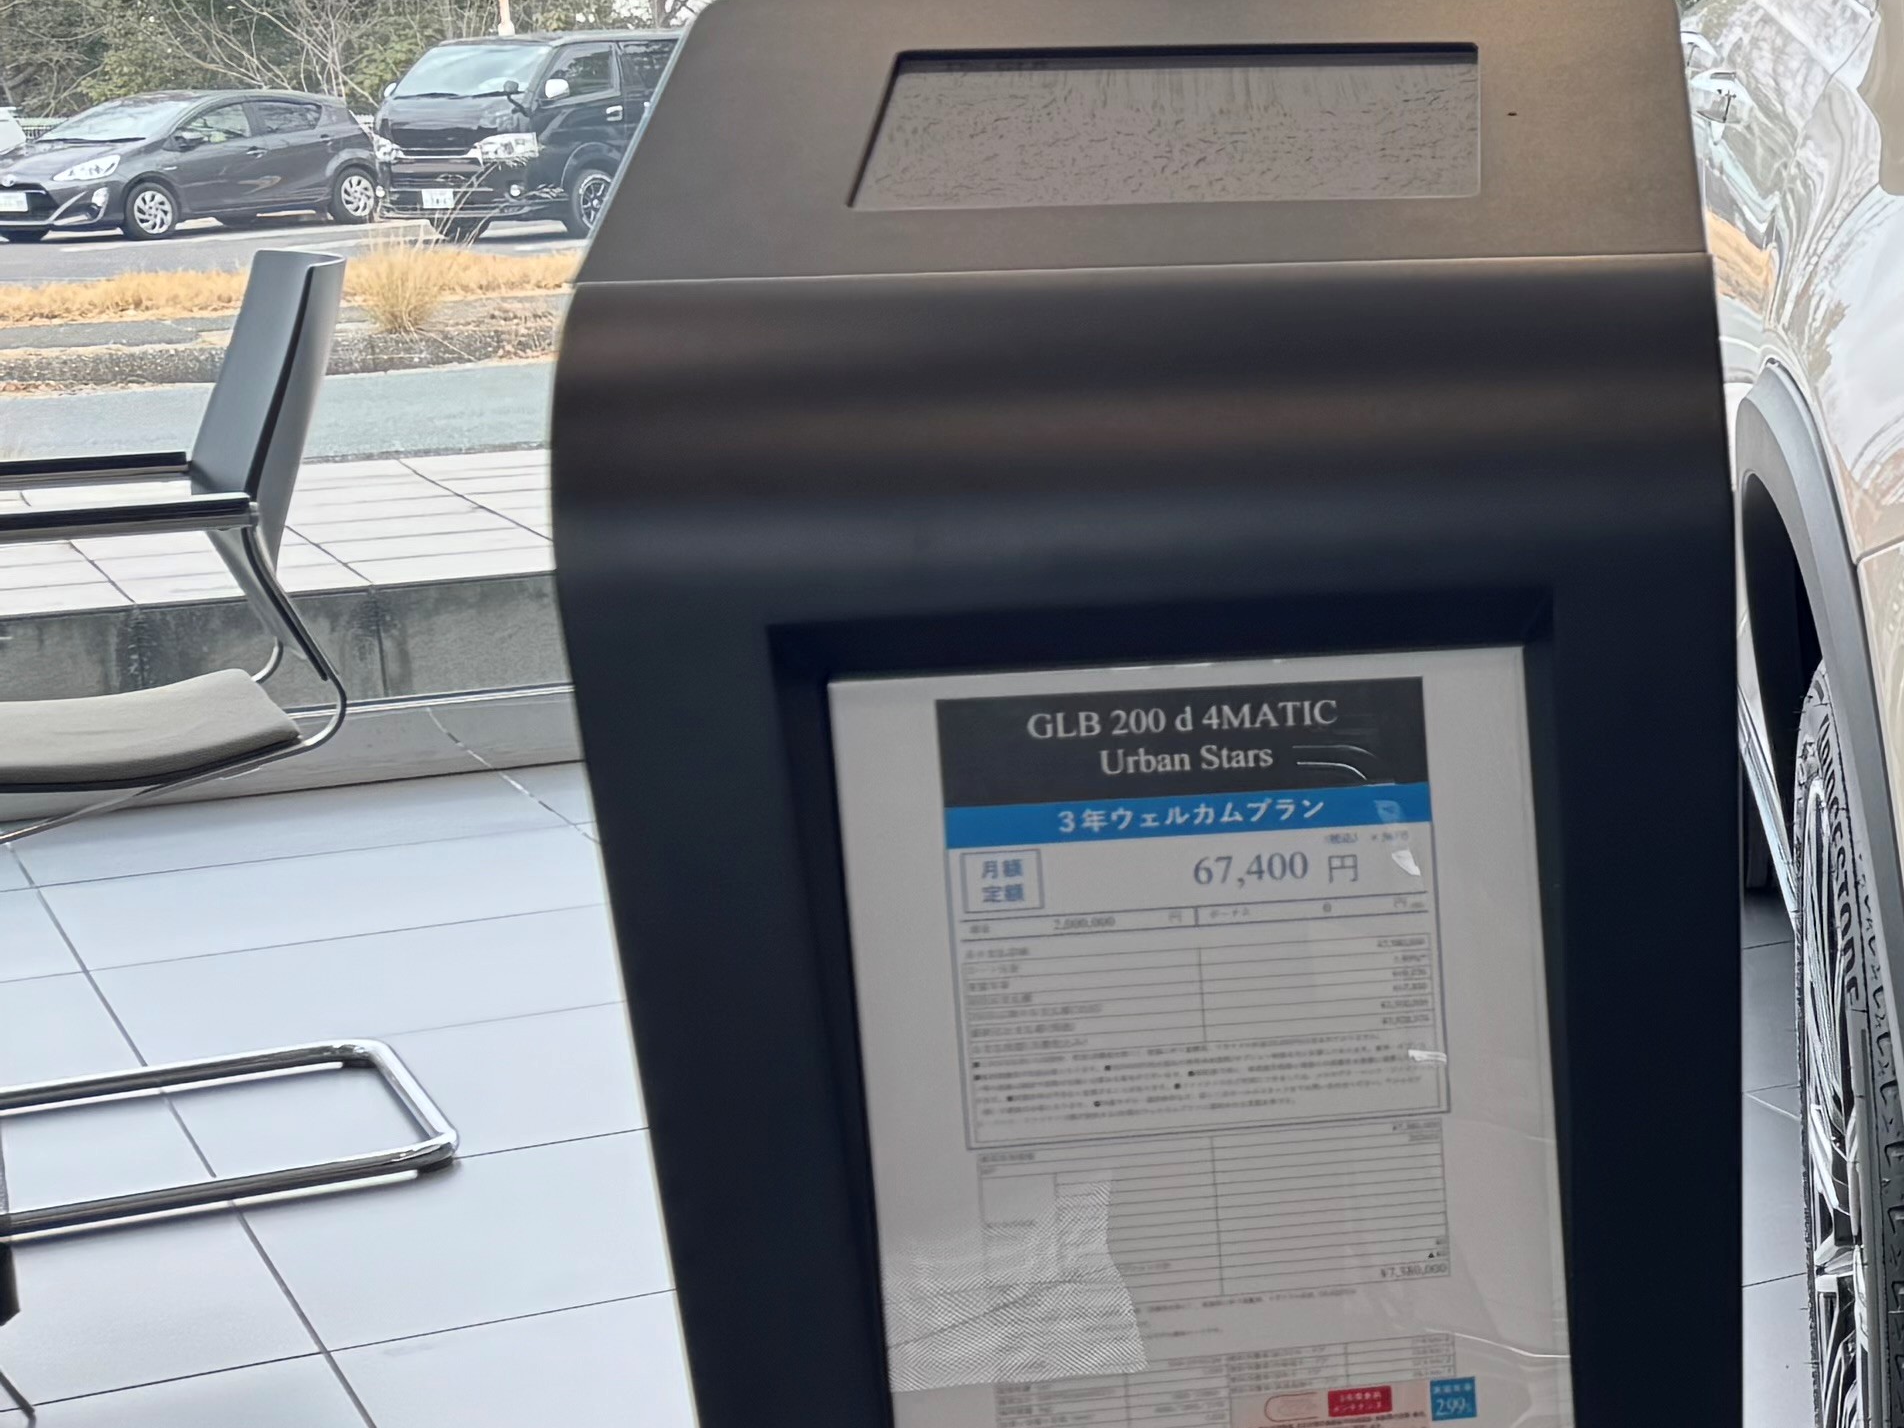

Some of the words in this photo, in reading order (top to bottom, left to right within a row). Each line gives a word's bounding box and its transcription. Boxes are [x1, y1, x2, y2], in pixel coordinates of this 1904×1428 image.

[1026, 711, 1101, 740] GLB
[1111, 708, 1167, 735] 200
[1174, 705, 1194, 733] d
[1202, 698, 1339, 731] 4MATIC
[1100, 746, 1192, 776] Urban
[1200, 743, 1275, 770] Stars
[1192, 850, 1310, 892] 67,400
[1327, 853, 1359, 884] 円
